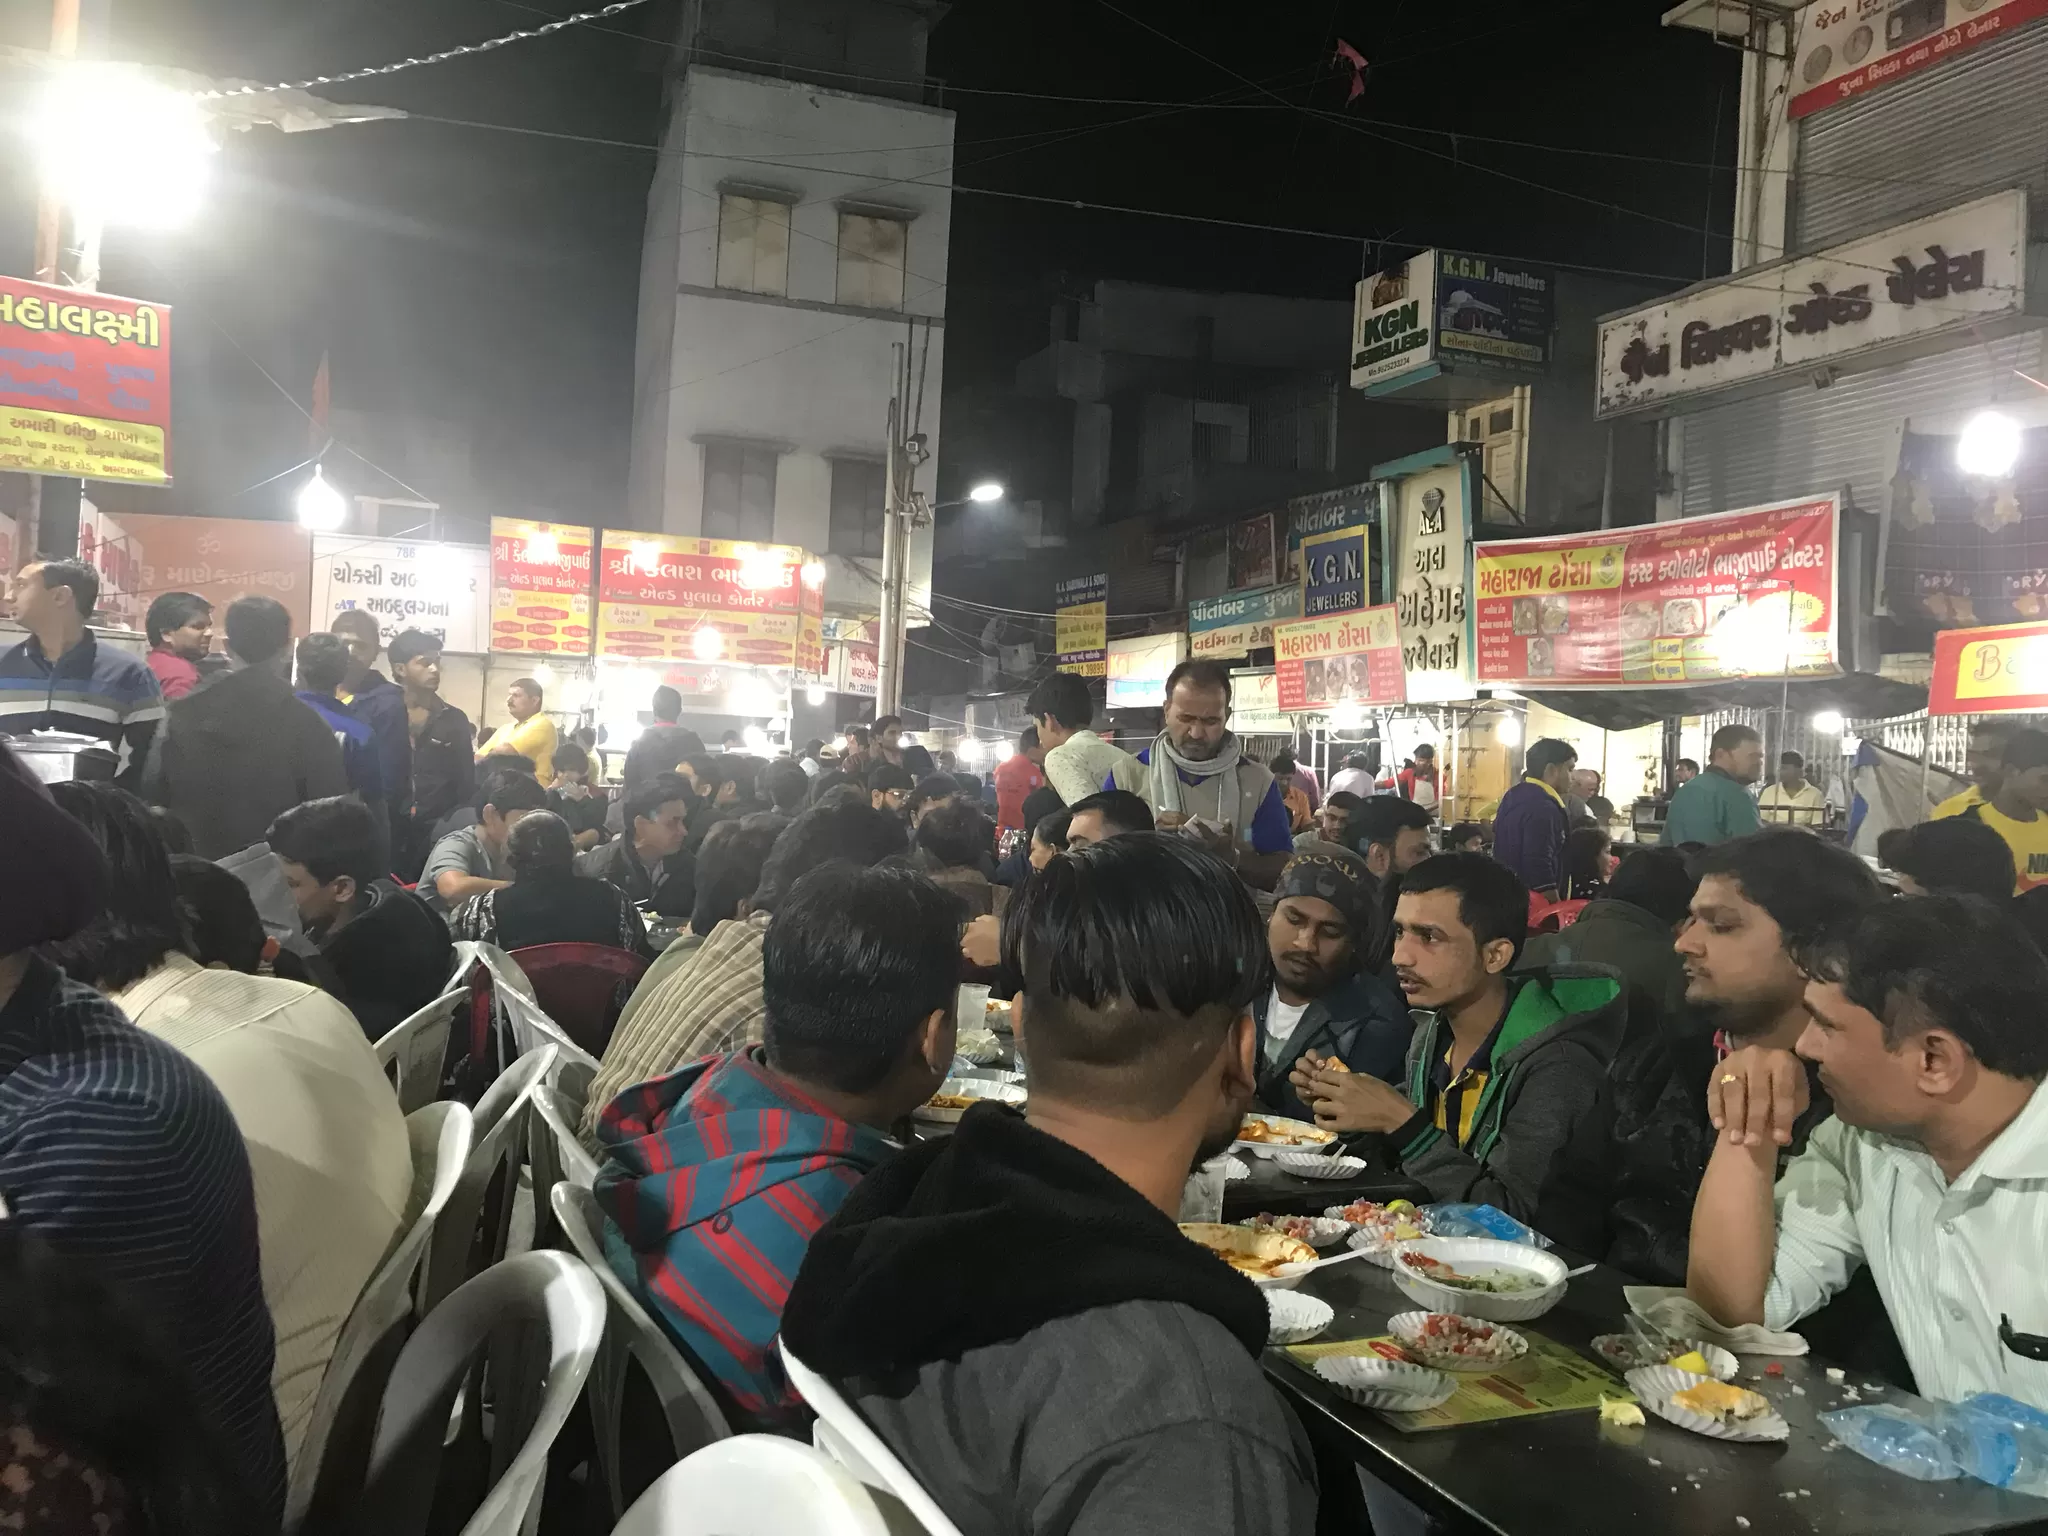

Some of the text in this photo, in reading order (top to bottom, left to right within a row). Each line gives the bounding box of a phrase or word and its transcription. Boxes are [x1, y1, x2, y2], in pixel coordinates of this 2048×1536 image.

[1493, 266, 1546, 292] Jewellers
[1364, 299, 1419, 347] KGN
[1352, 327, 1429, 371] JEWELLERS
[104, 429, 138, 444] શાખા
[396, 546, 416, 559] 786
[639, 582, 677, 601] એન્ડ
[683, 589, 722, 608] પુલાવ
[1306, 590, 1358, 613] JEWELLERS
